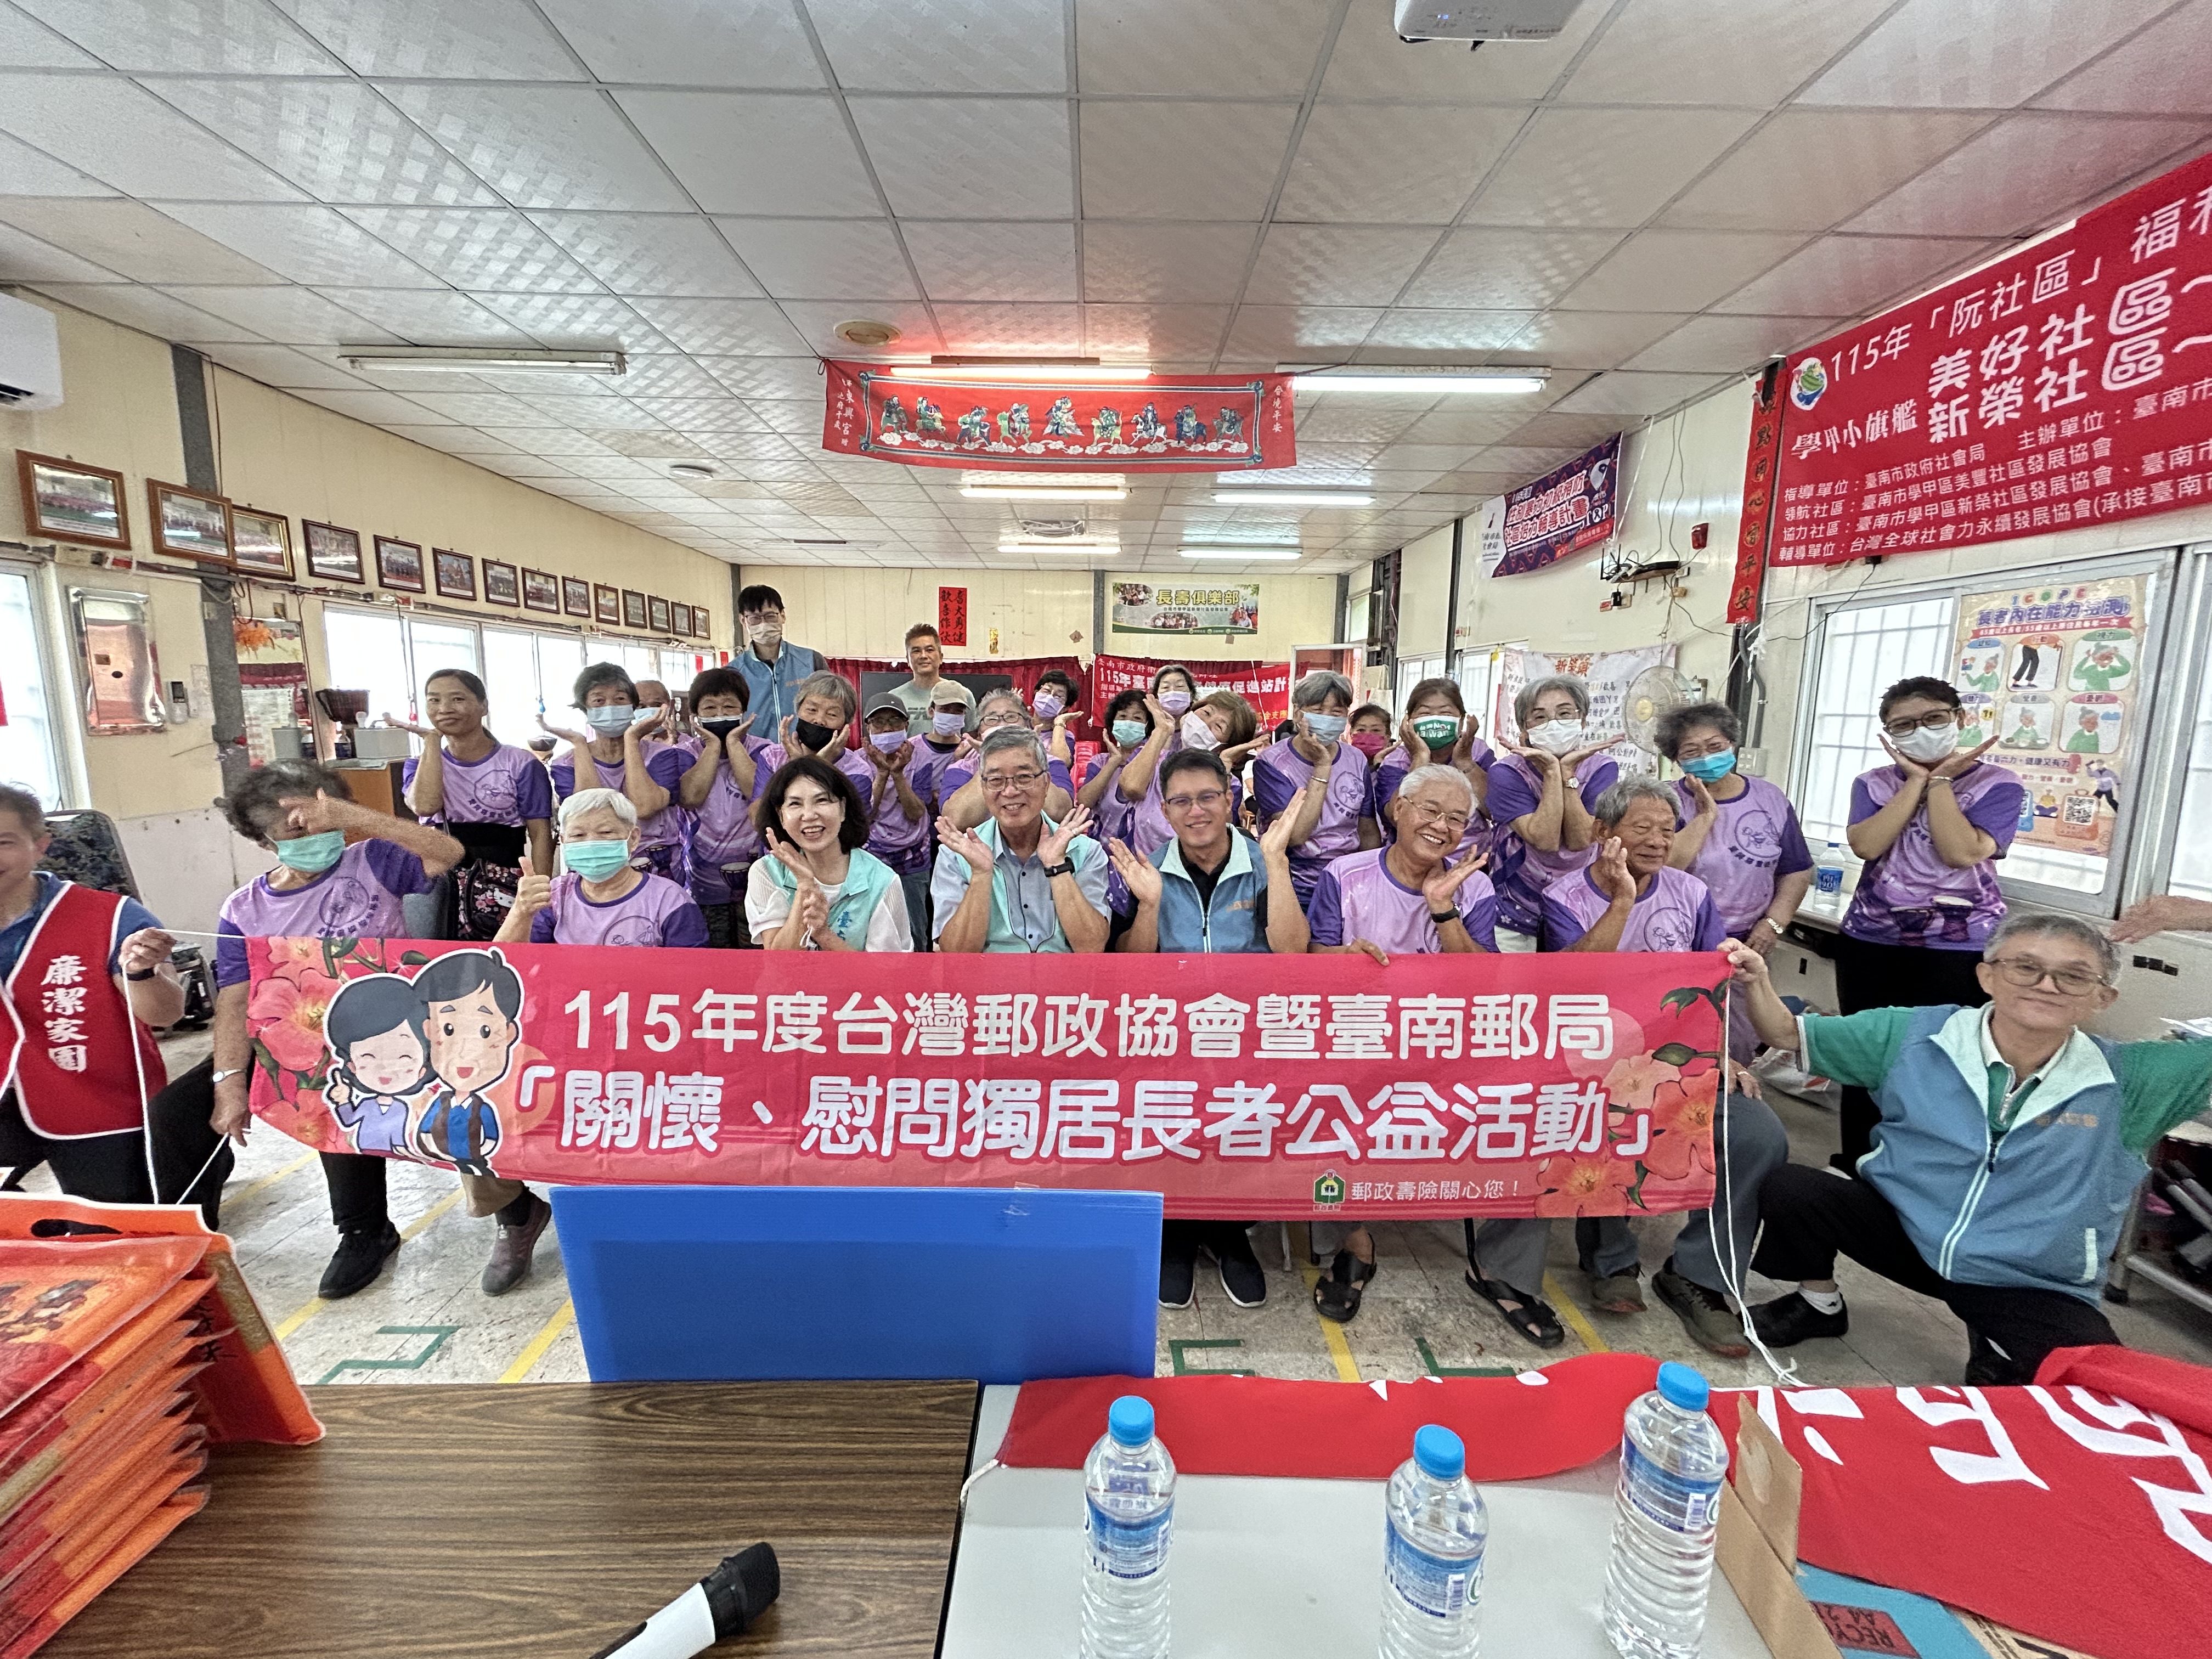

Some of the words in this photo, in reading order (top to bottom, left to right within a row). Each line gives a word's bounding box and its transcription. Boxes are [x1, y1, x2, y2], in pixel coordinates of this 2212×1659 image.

[1272, 385, 1283, 432] 合境平安
[1791, 398, 1918, 460] 學甲小旗艦
[1784, 443, 1986, 503] 指導單位：臺南市政府社會局
[1785, 437, 2112, 521] 領航社區：臺南市學甲區美豐社區發展協會
[1156, 589, 1239, 606] 長壽俱樂部
[41, 955, 89, 1073] 廉潔家園
[564, 988, 1615, 1060] 115年度台灣郵政協會暨臺南郵局
[518, 1065, 1649, 1160] 「關懷、慰問獨居長者公益活動」
[1351, 1180, 1518, 1201] 郵政壽險關心您！
